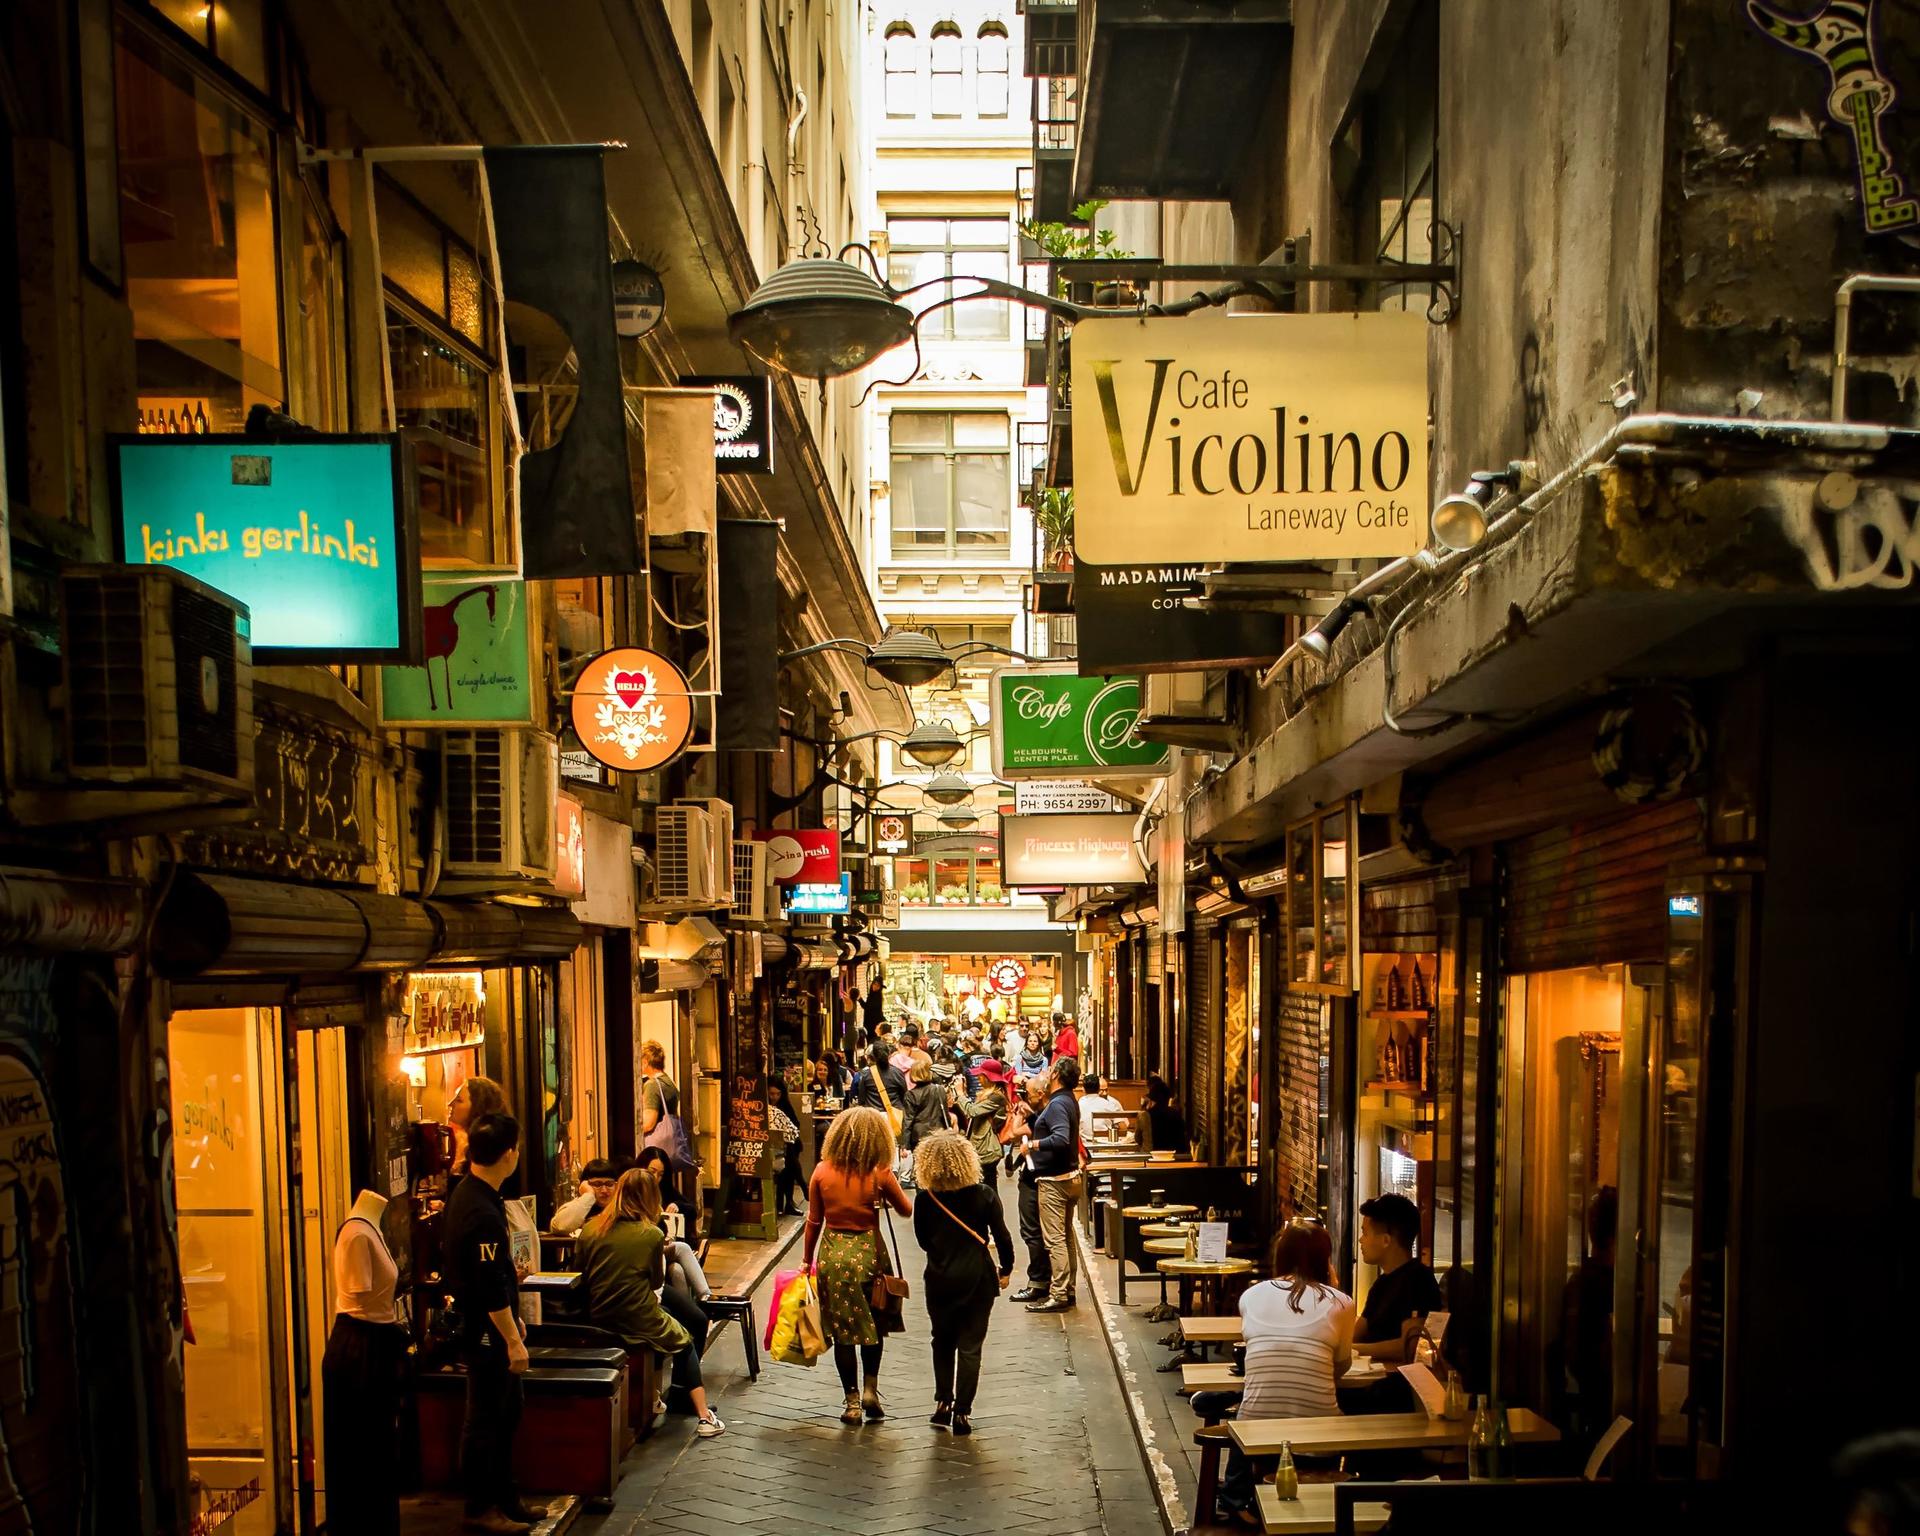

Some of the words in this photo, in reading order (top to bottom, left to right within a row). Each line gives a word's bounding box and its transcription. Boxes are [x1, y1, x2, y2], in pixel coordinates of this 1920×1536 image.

[1177, 369, 1249, 410] Cafe
[1087, 359, 1410, 497] Vicolino
[714, 442, 760, 459] wkers
[1247, 502, 1347, 535] Laneway
[1356, 501, 1409, 528] Cafe
[1101, 568, 1198, 586] MADAMIM
[1152, 598, 1181, 610] COF
[1012, 685, 1073, 729] Cafe
[1013, 748, 1069, 756] MELBOURNE
[1014, 755, 1049, 763] CENTER
[1051, 754, 1080, 762] PLACE
[1020, 799, 1040, 810] PH:
[1043, 799, 1074, 810] 9654
[1077, 798, 1107, 809] 2997
[804, 844, 830, 858] rush
[1020, 837, 1076, 862] Princess
[1078, 837, 1129, 862] Highway
[736, 1076, 758, 1091] PAY
[726, 1146, 763, 1158] FACEBOOK
[479, 1242, 499, 1262] IV
